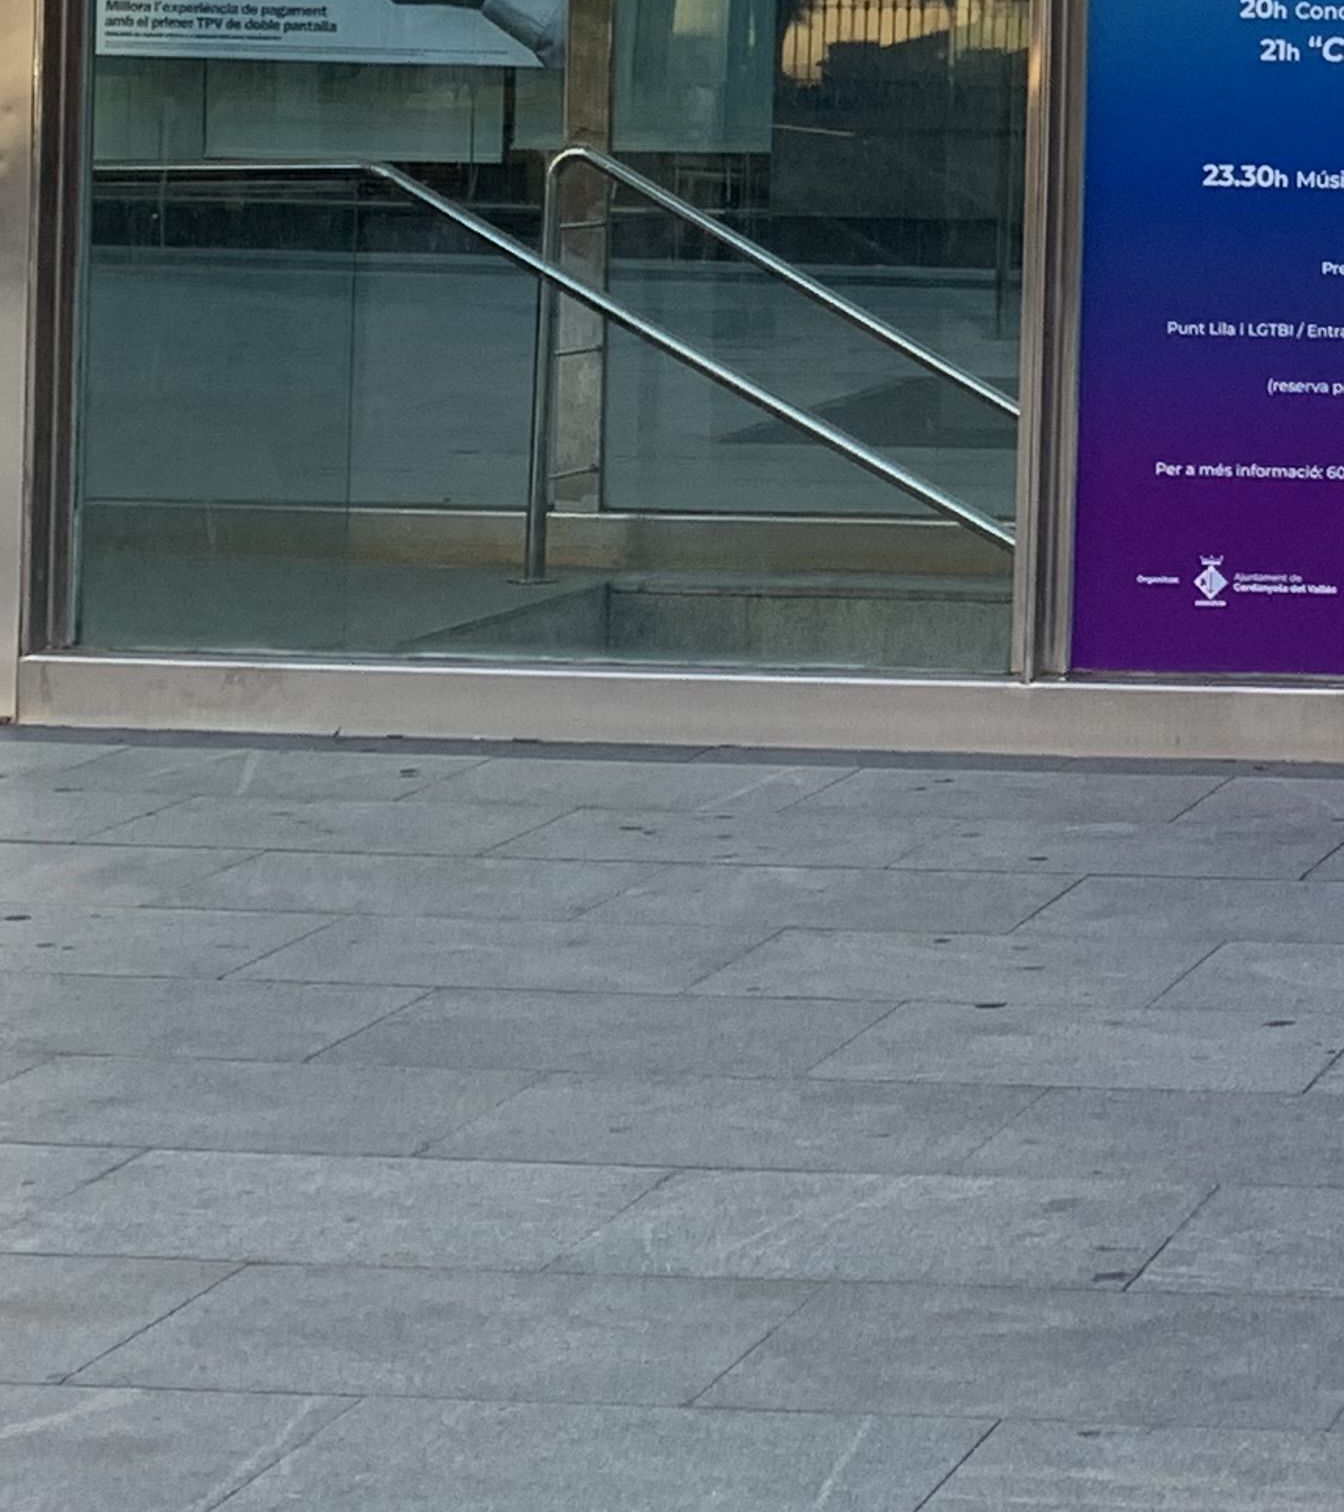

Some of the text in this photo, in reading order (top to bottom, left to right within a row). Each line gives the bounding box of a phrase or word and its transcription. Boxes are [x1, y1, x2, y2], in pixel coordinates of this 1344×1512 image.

[106, 0, 151, 14] Millora
[241, 3, 258, 16] de
[260, 4, 328, 22] pagament
[104, 15, 134, 28] amb
[244, 19, 281, 33] doble
[283, 21, 338, 36] pantalla
[1259, 39, 1301, 62] 21h
[1202, 163, 1289, 188] 23.30h
[1167, 321, 1205, 336] Punt
[1209, 321, 1236, 337] Lila
[1248, 323, 1294, 338] LGTBI
[1267, 378, 1330, 396] (reserva
[1155, 462, 1181, 475] Per
[1185, 465, 1195, 475] a
[1199, 462, 1232, 477] més
[1236, 464, 1323, 479] informació:
